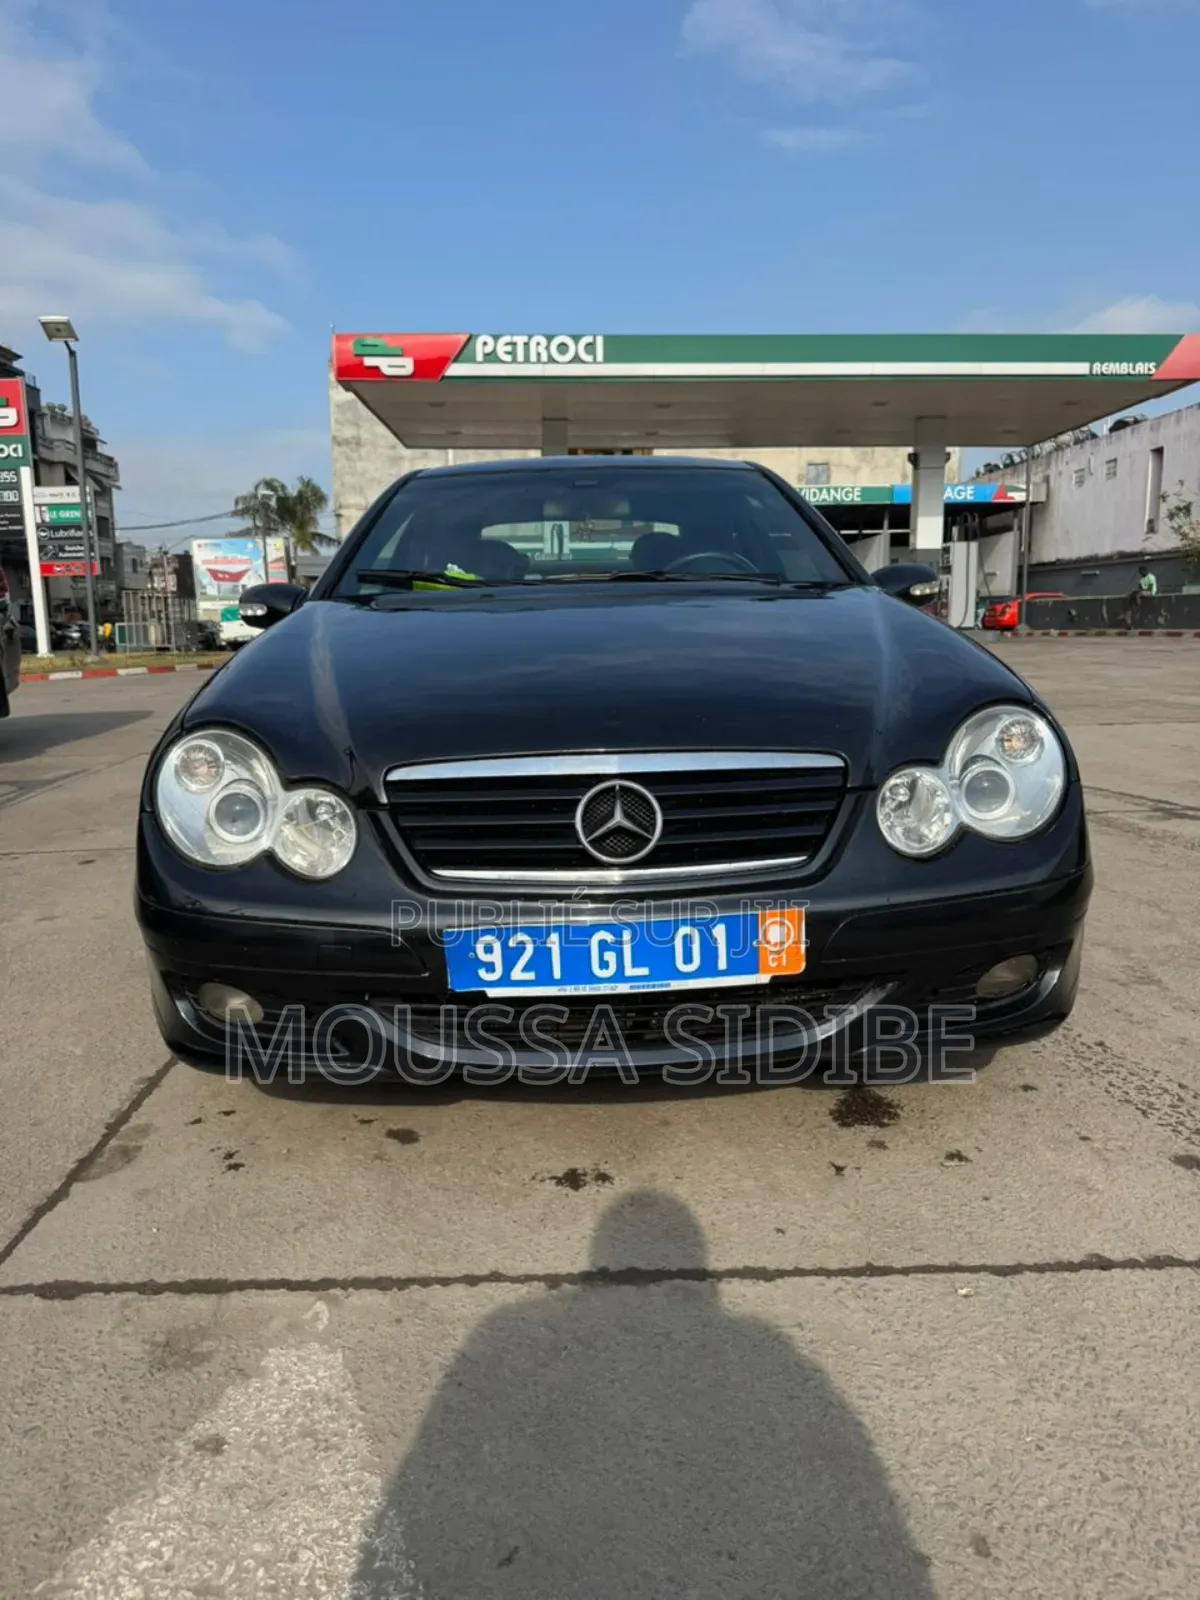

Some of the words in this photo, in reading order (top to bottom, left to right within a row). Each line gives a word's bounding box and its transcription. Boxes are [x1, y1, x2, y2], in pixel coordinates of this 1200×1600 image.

[475, 335, 604, 363] PETROCI
[1092, 362, 1156, 376] REMBLAIS
[943, 485, 975, 500] AGE
[475, 923, 562, 982] 921
[591, 930, 649, 978] GL
[675, 923, 728, 973] 01
